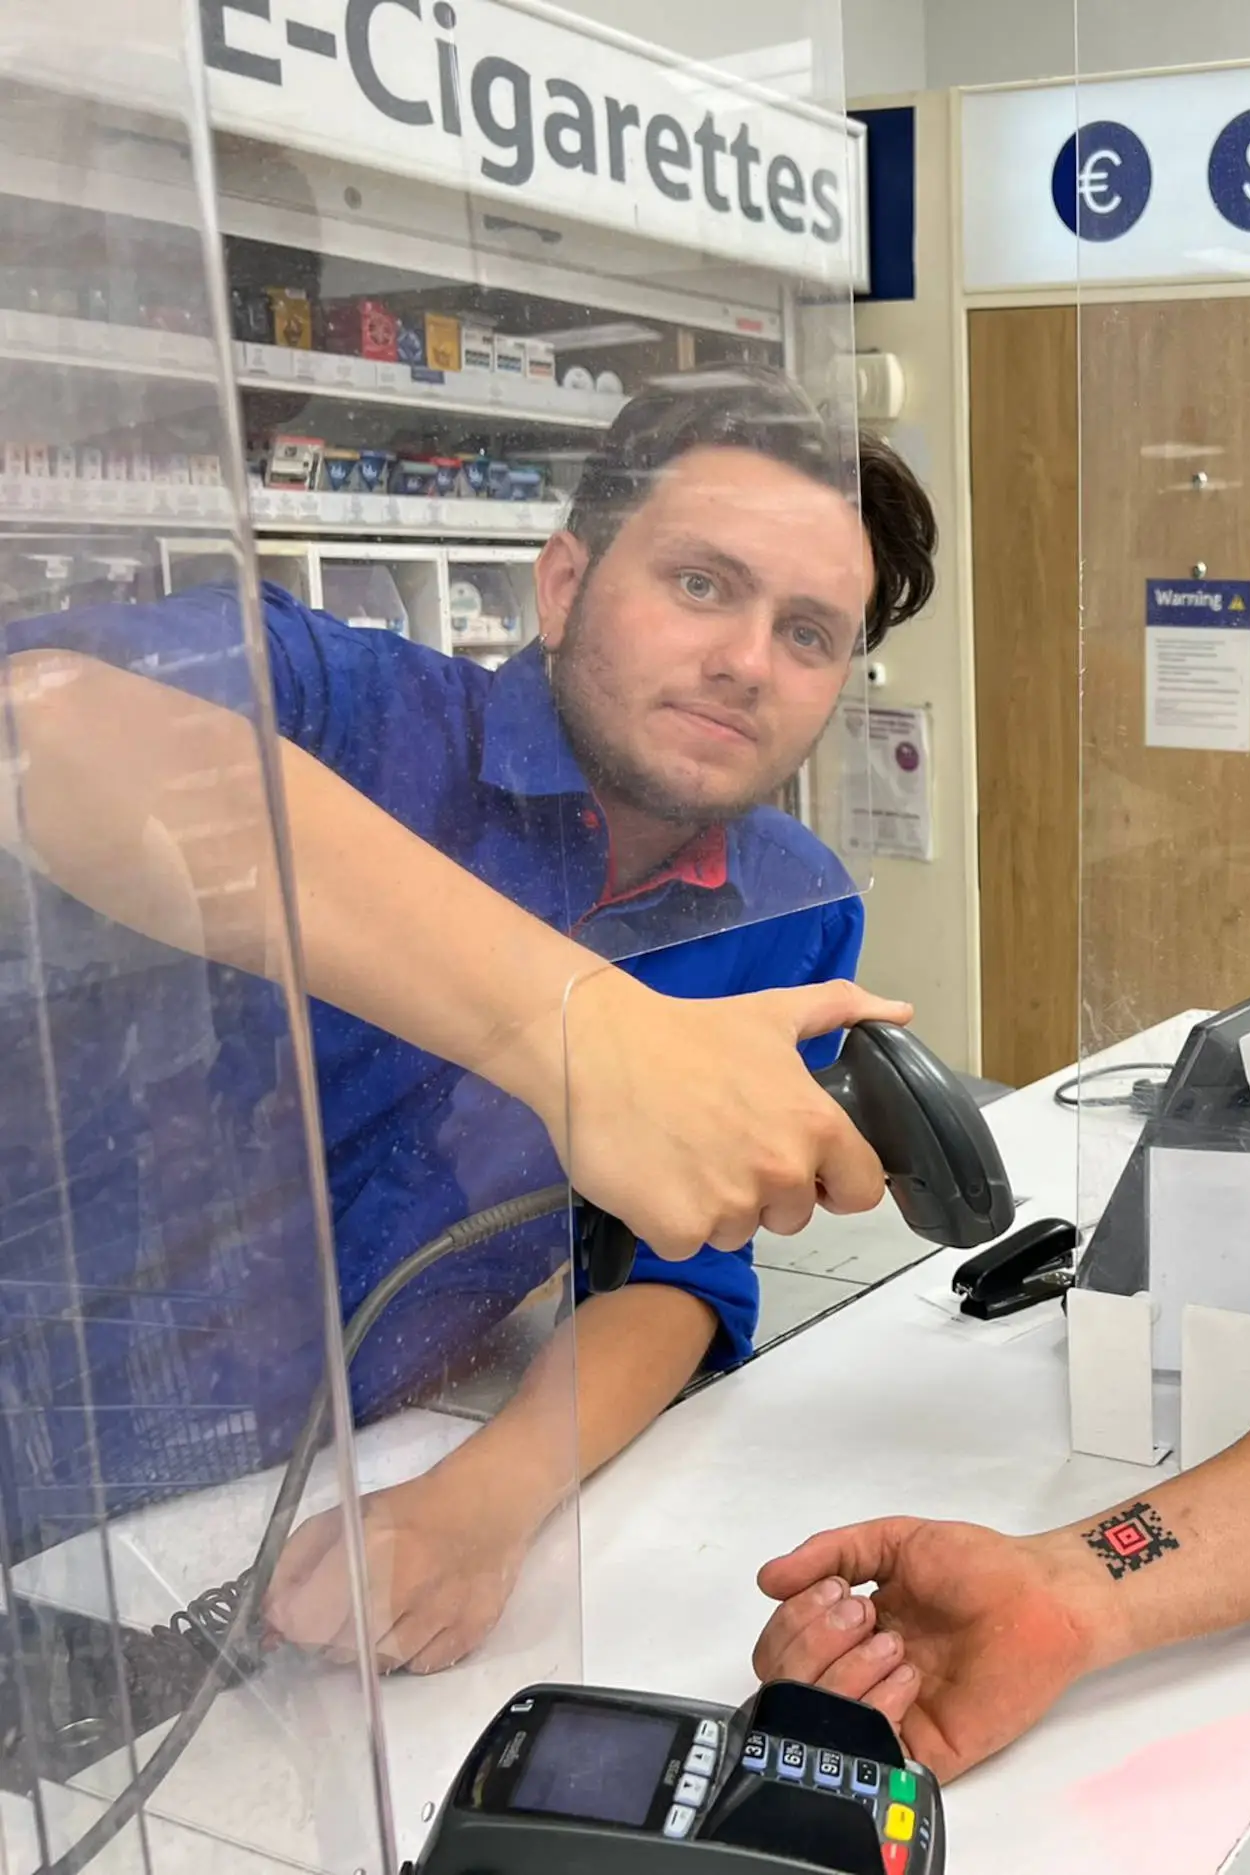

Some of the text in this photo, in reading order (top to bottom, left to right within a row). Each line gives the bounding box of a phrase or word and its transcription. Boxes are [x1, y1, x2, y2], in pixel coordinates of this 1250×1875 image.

[200, 0, 843, 243] E-Cigarettes
[1154, 588, 1223, 612] Warning
[784, 1753, 800, 1765] 6
[821, 1763, 838, 1774] 9
